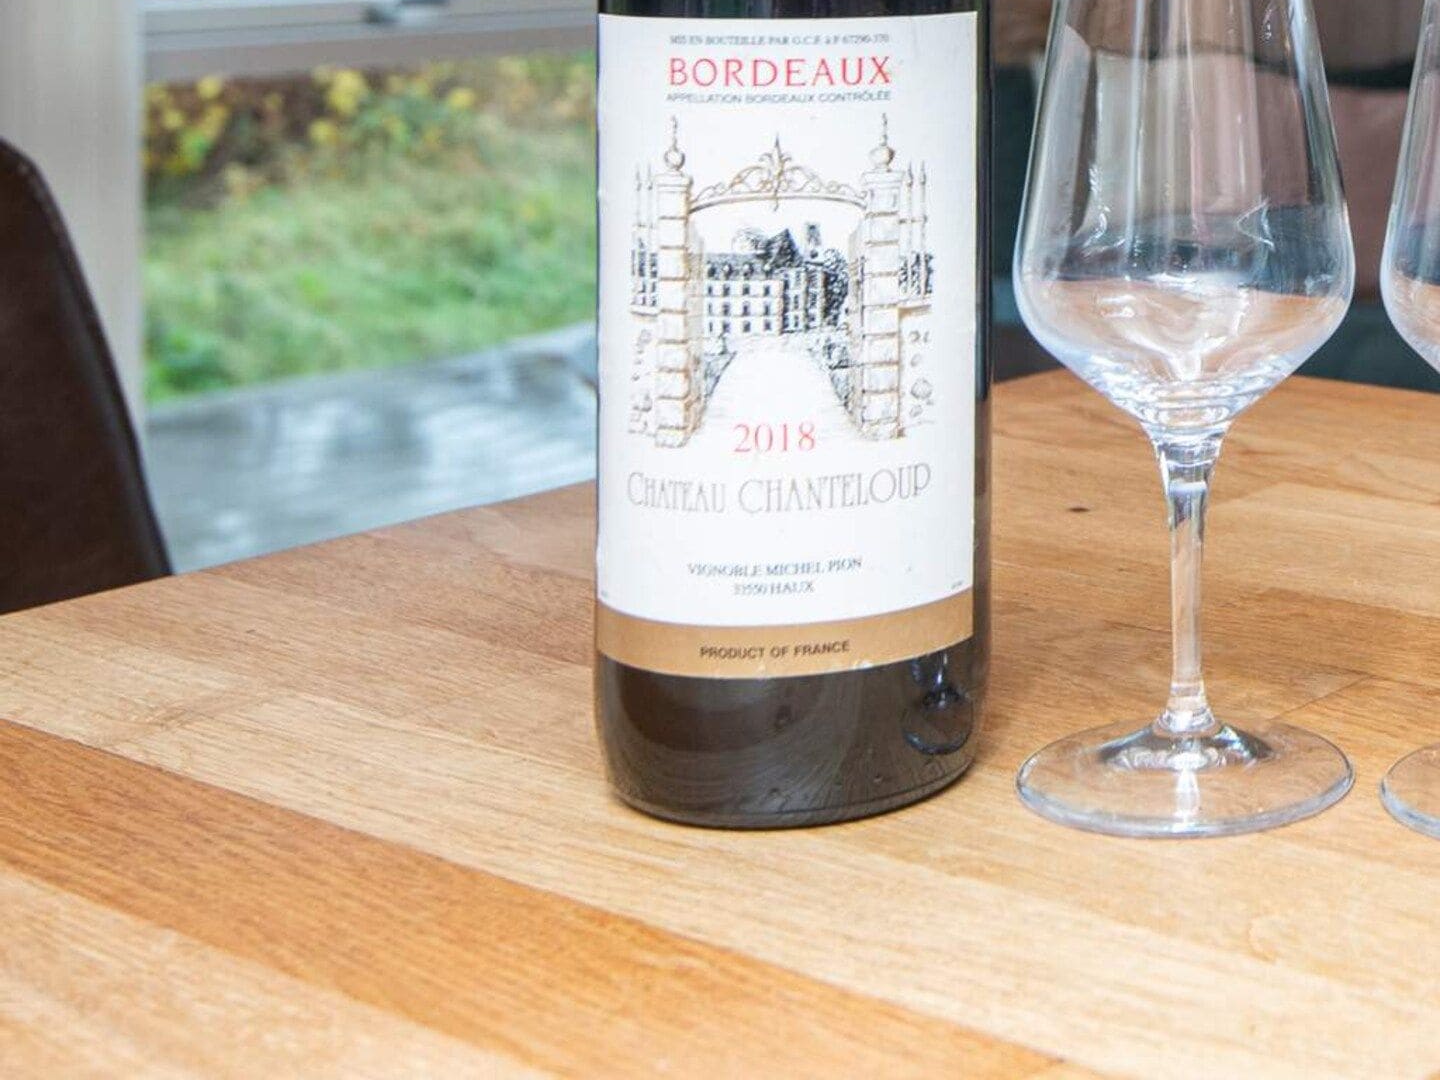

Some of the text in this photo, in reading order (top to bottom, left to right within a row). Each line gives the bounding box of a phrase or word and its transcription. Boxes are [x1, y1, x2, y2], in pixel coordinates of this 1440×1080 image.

[669, 56, 890, 87] BORDEAUX
[667, 92, 741, 103] APPELLATION
[746, 93, 814, 103] BORDEAUX
[734, 422, 816, 452] 2018
[739, 462, 931, 513] CHANTELOUP
[700, 639, 850, 660] PRODUCT OF FRANCE
